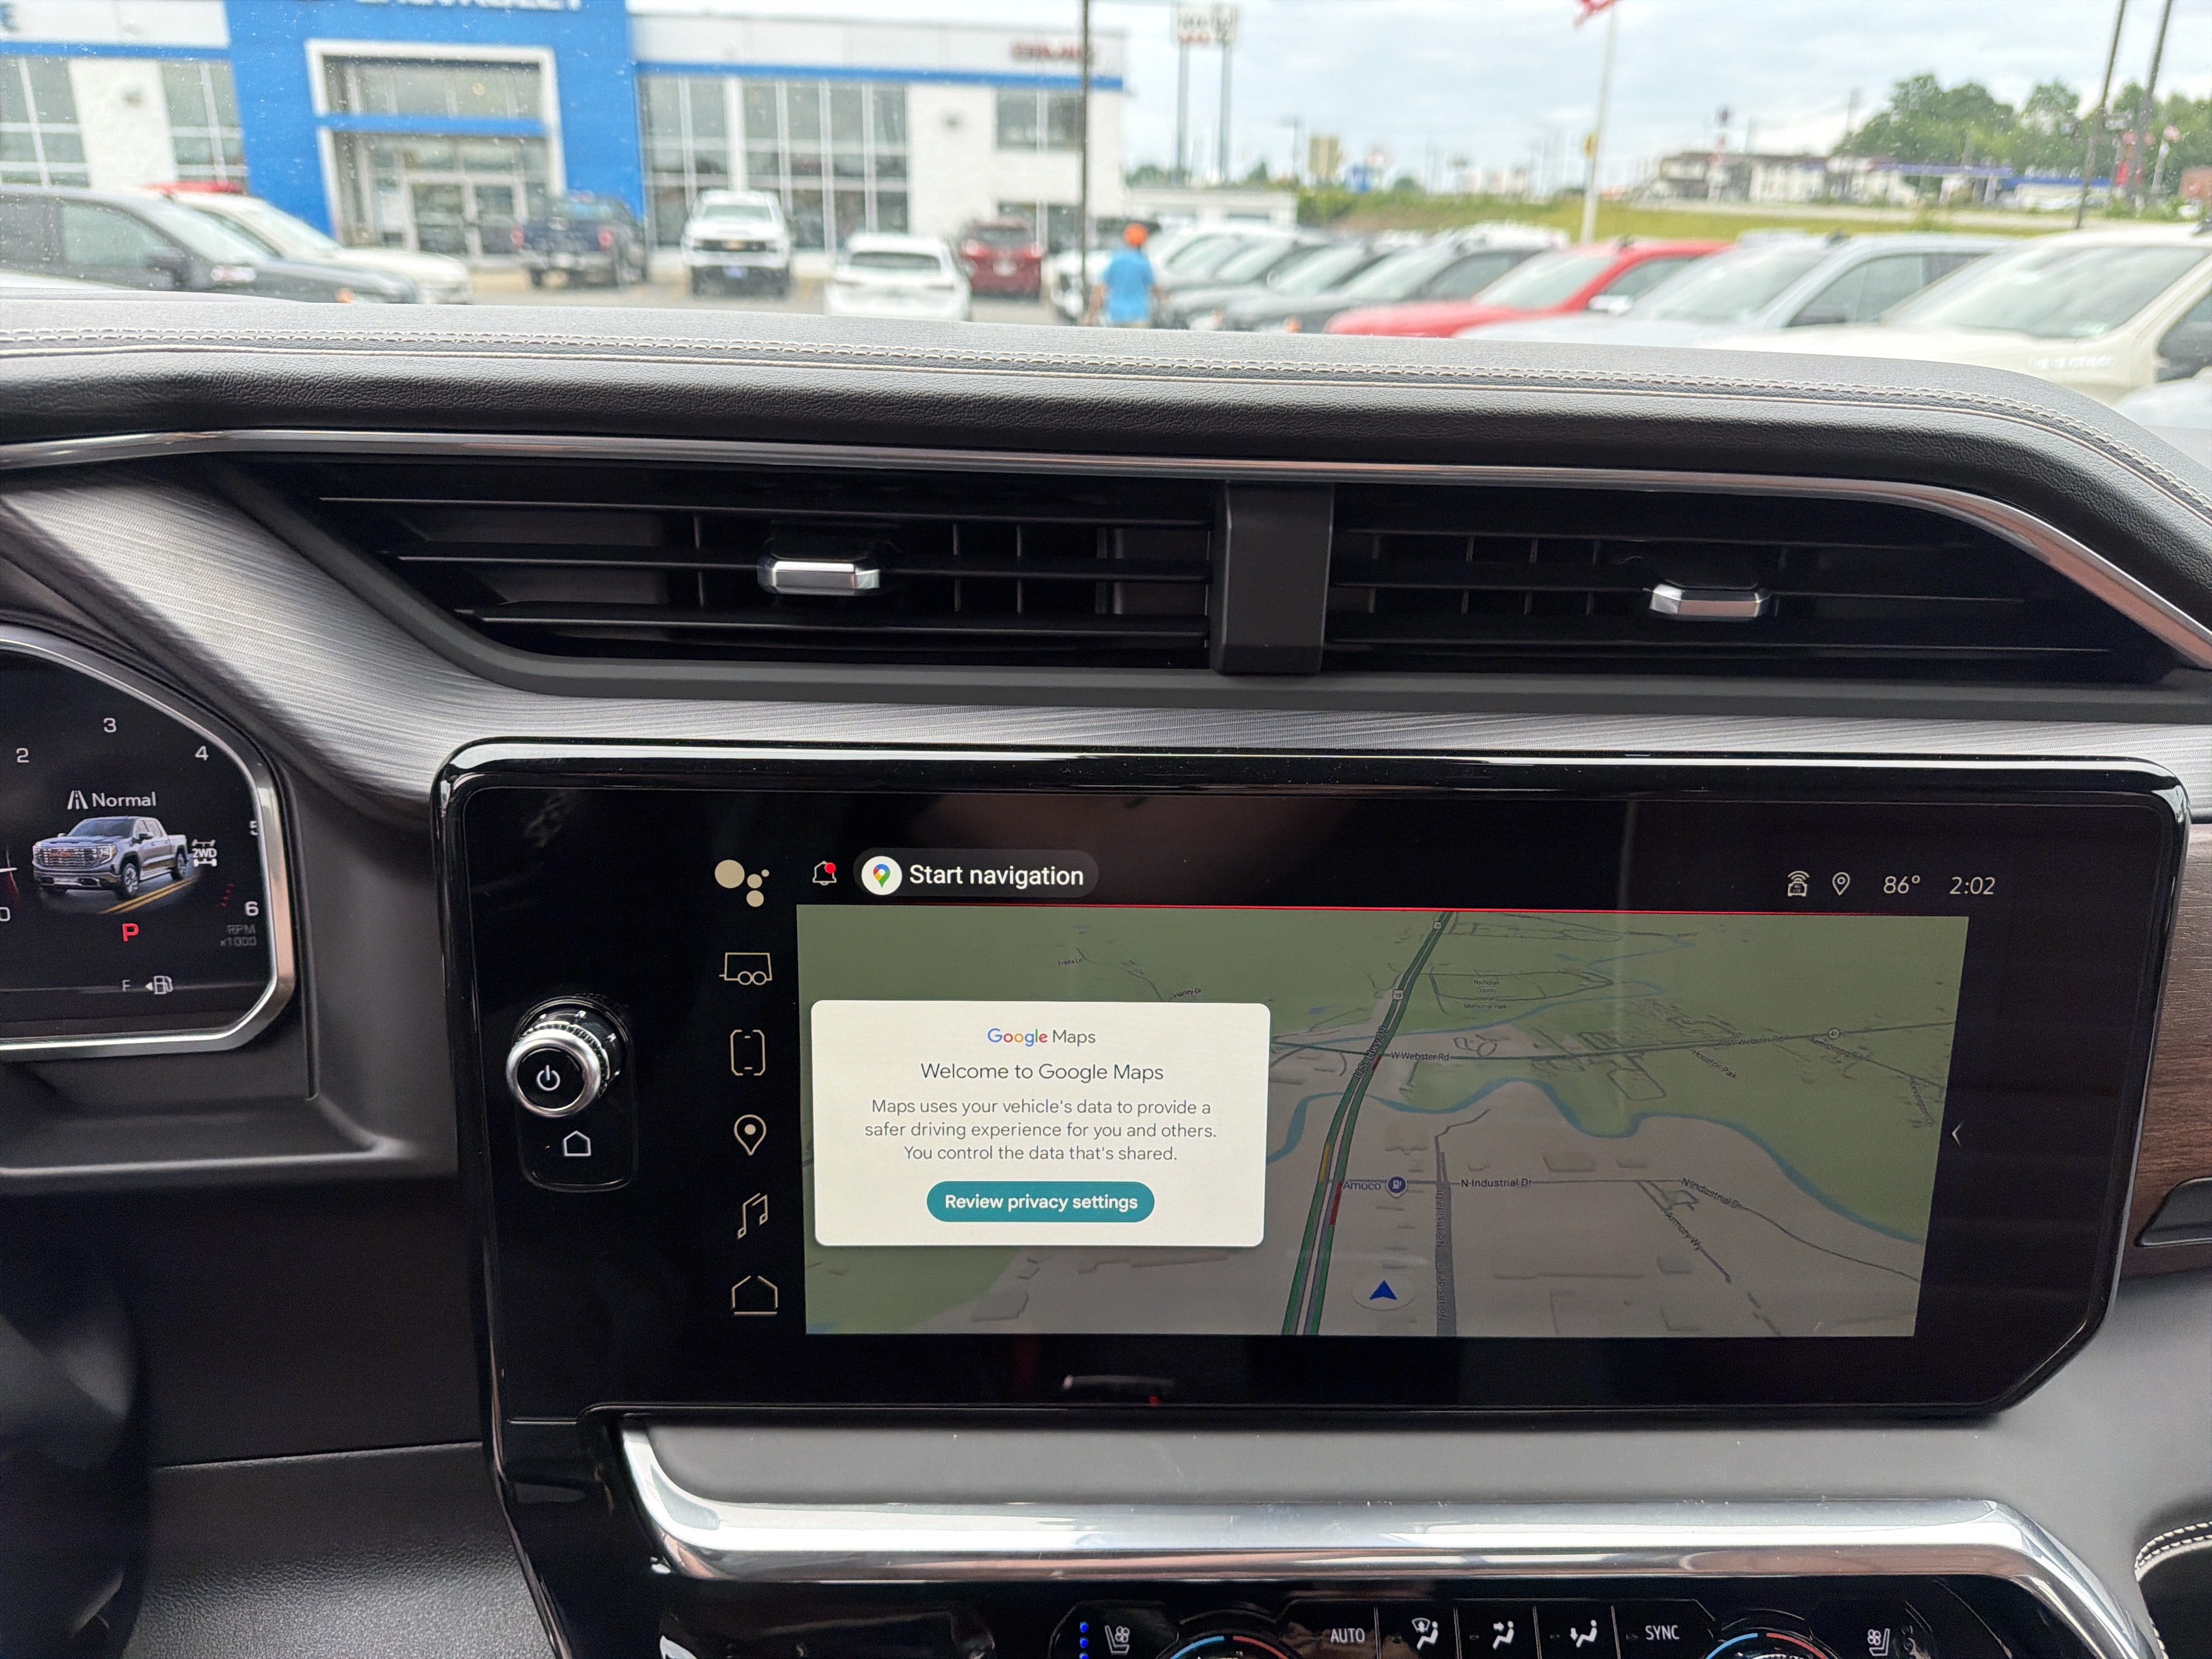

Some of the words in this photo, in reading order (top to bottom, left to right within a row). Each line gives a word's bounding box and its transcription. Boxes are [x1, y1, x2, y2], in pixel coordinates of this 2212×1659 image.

[103, 717, 117, 732] 3
[16, 748, 30, 763] 2
[195, 746, 209, 761] 4
[92, 791, 157, 808] Normal
[193, 848, 217, 858] 2WD
[910, 864, 963, 884] Start
[970, 865, 1084, 889] navigation
[1883, 875, 1920, 894] 86°
[1949, 877, 1995, 895] 2:02
[245, 901, 259, 916] 6
[122, 923, 139, 942] P
[228, 924, 256, 935] RPM
[122, 979, 131, 991] F
[988, 1028, 1048, 1047] Google
[1053, 1030, 1096, 1047] Maps
[1365, 1039, 1384, 1060] Hwy
[1401, 1051, 1436, 1060] Webster
[921, 1063, 1008, 1079] Welcome
[1014, 1064, 1033, 1079] to
[1039, 1063, 1108, 1084] Google
[1114, 1064, 1164, 1084] Maps
[872, 1099, 915, 1116] Maps
[920, 1102, 957, 1113] uses
[962, 1102, 998, 1116] your
[1003, 1098, 1073, 1113] vehicle's
[1077, 1099, 1112, 1114] data
[1117, 1101, 1132, 1114] to
[1138, 1099, 1197, 1117] provide
[1201, 1104, 1211, 1114] a
[865, 1121, 906, 1136] safer
[911, 1122, 966, 1139] driving
[971, 1122, 1061, 1139] experience
[1066, 1122, 1089, 1136] for
[1093, 1126, 1121, 1139] you
[1127, 1123, 1156, 1137] and
[1161, 1123, 1216, 1137] others.
[904, 1146, 932, 1159] You
[938, 1146, 992, 1159] control
[997, 1146, 1024, 1159] the
[1029, 1146, 1064, 1160] data
[1069, 1146, 1114, 1160] that's
[1118, 1146, 1177, 1160] shared.
[1344, 1181, 1381, 1190] Amoco
[1460, 1179, 1468, 1187] N
[1471, 1178, 1519, 1187] Industrial
[1521, 1178, 1532, 1186] Dr
[945, 1194, 1003, 1209] Review
[1008, 1194, 1069, 1212] privacy
[1072, 1194, 1138, 1212] settings
[1330, 1628, 1365, 1643] AUTO
[1645, 1624, 1680, 1640] SYNC
